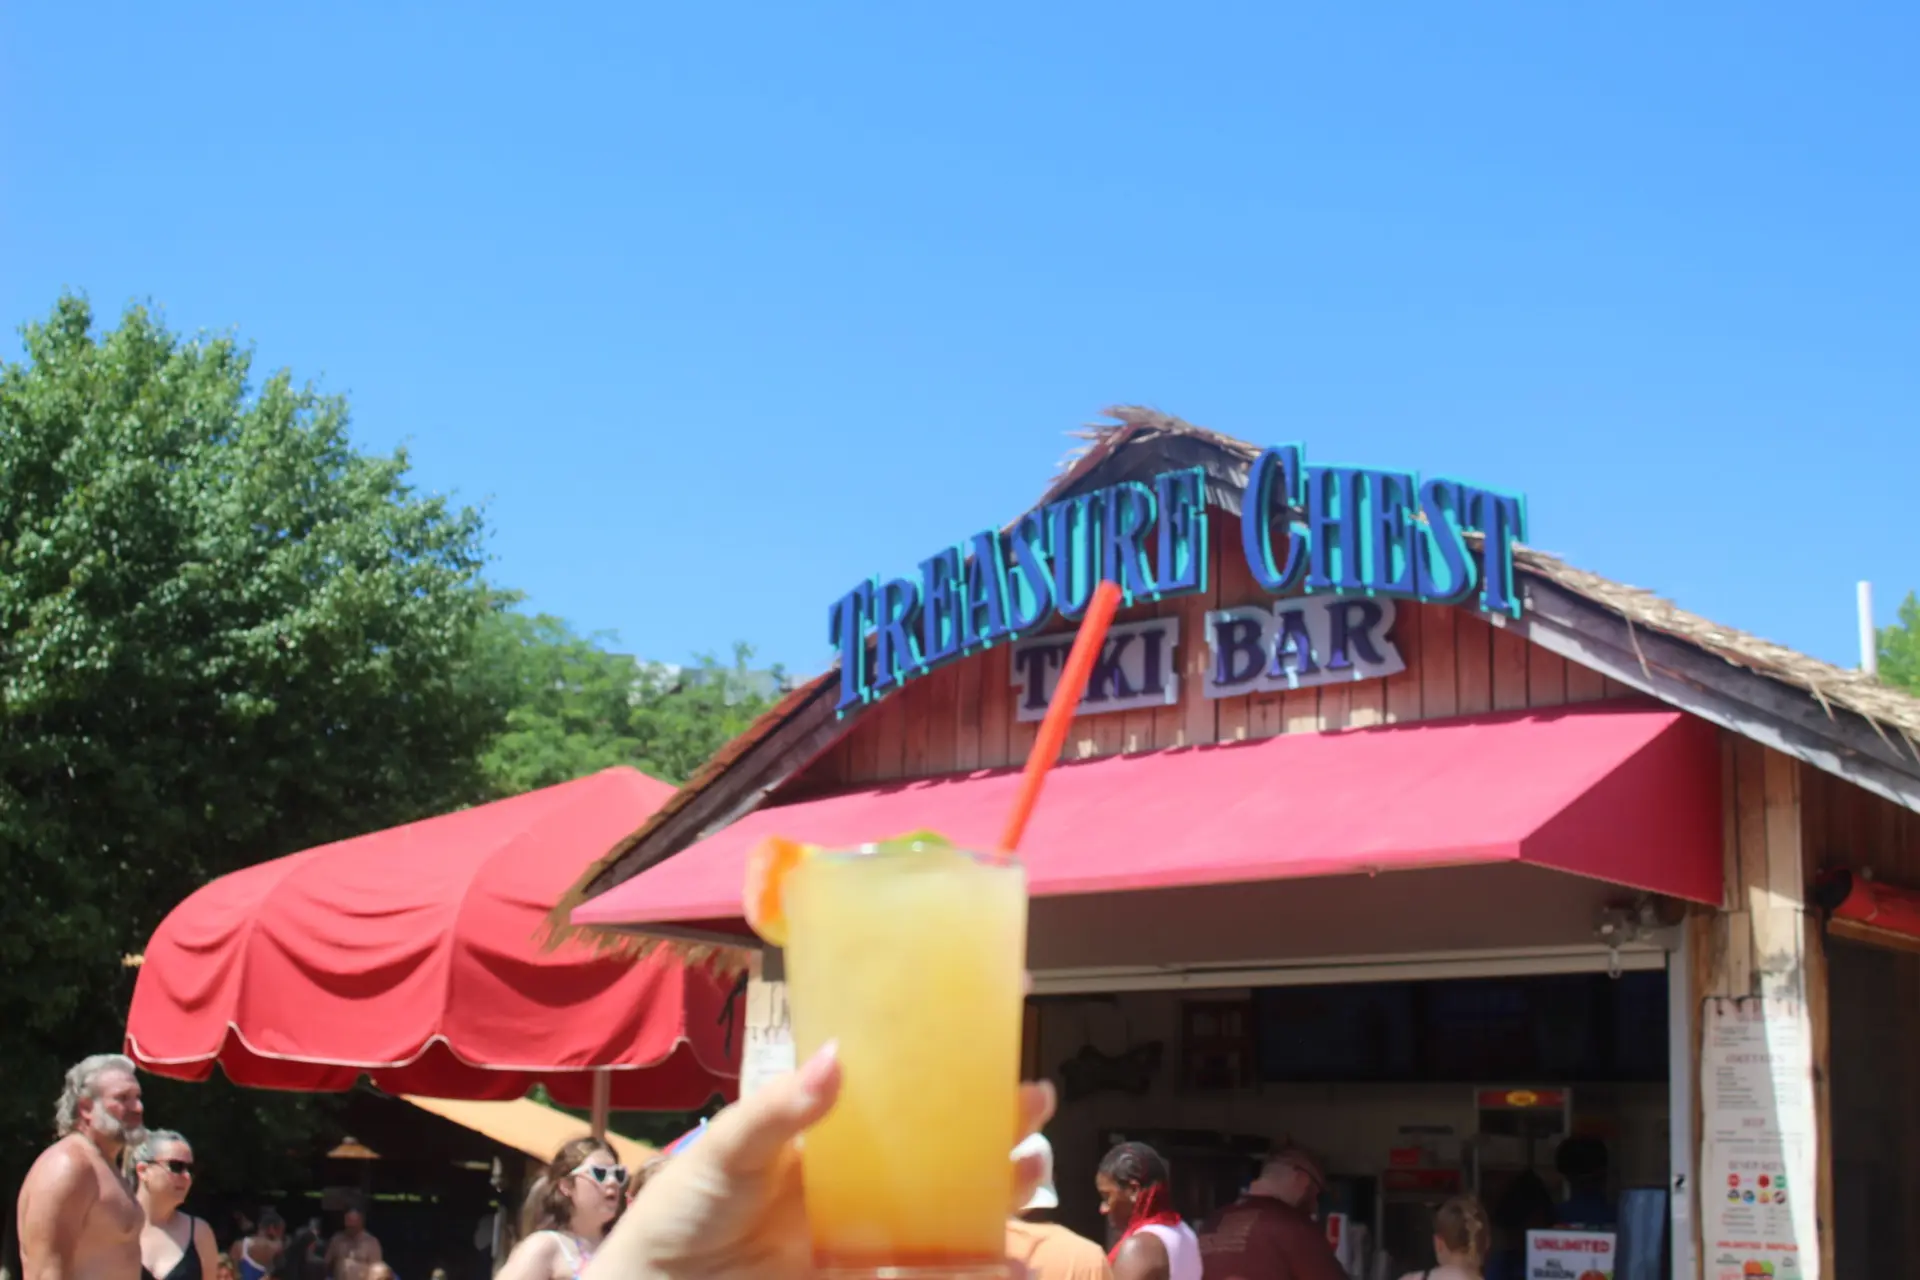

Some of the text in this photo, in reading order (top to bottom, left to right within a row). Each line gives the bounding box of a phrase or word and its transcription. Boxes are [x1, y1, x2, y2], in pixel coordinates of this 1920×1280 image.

[829, 441, 1528, 720] TREASURE CHEST
[1015, 600, 1385, 710] TKI BAR
[1534, 1237, 1611, 1254] UNLIMITED
